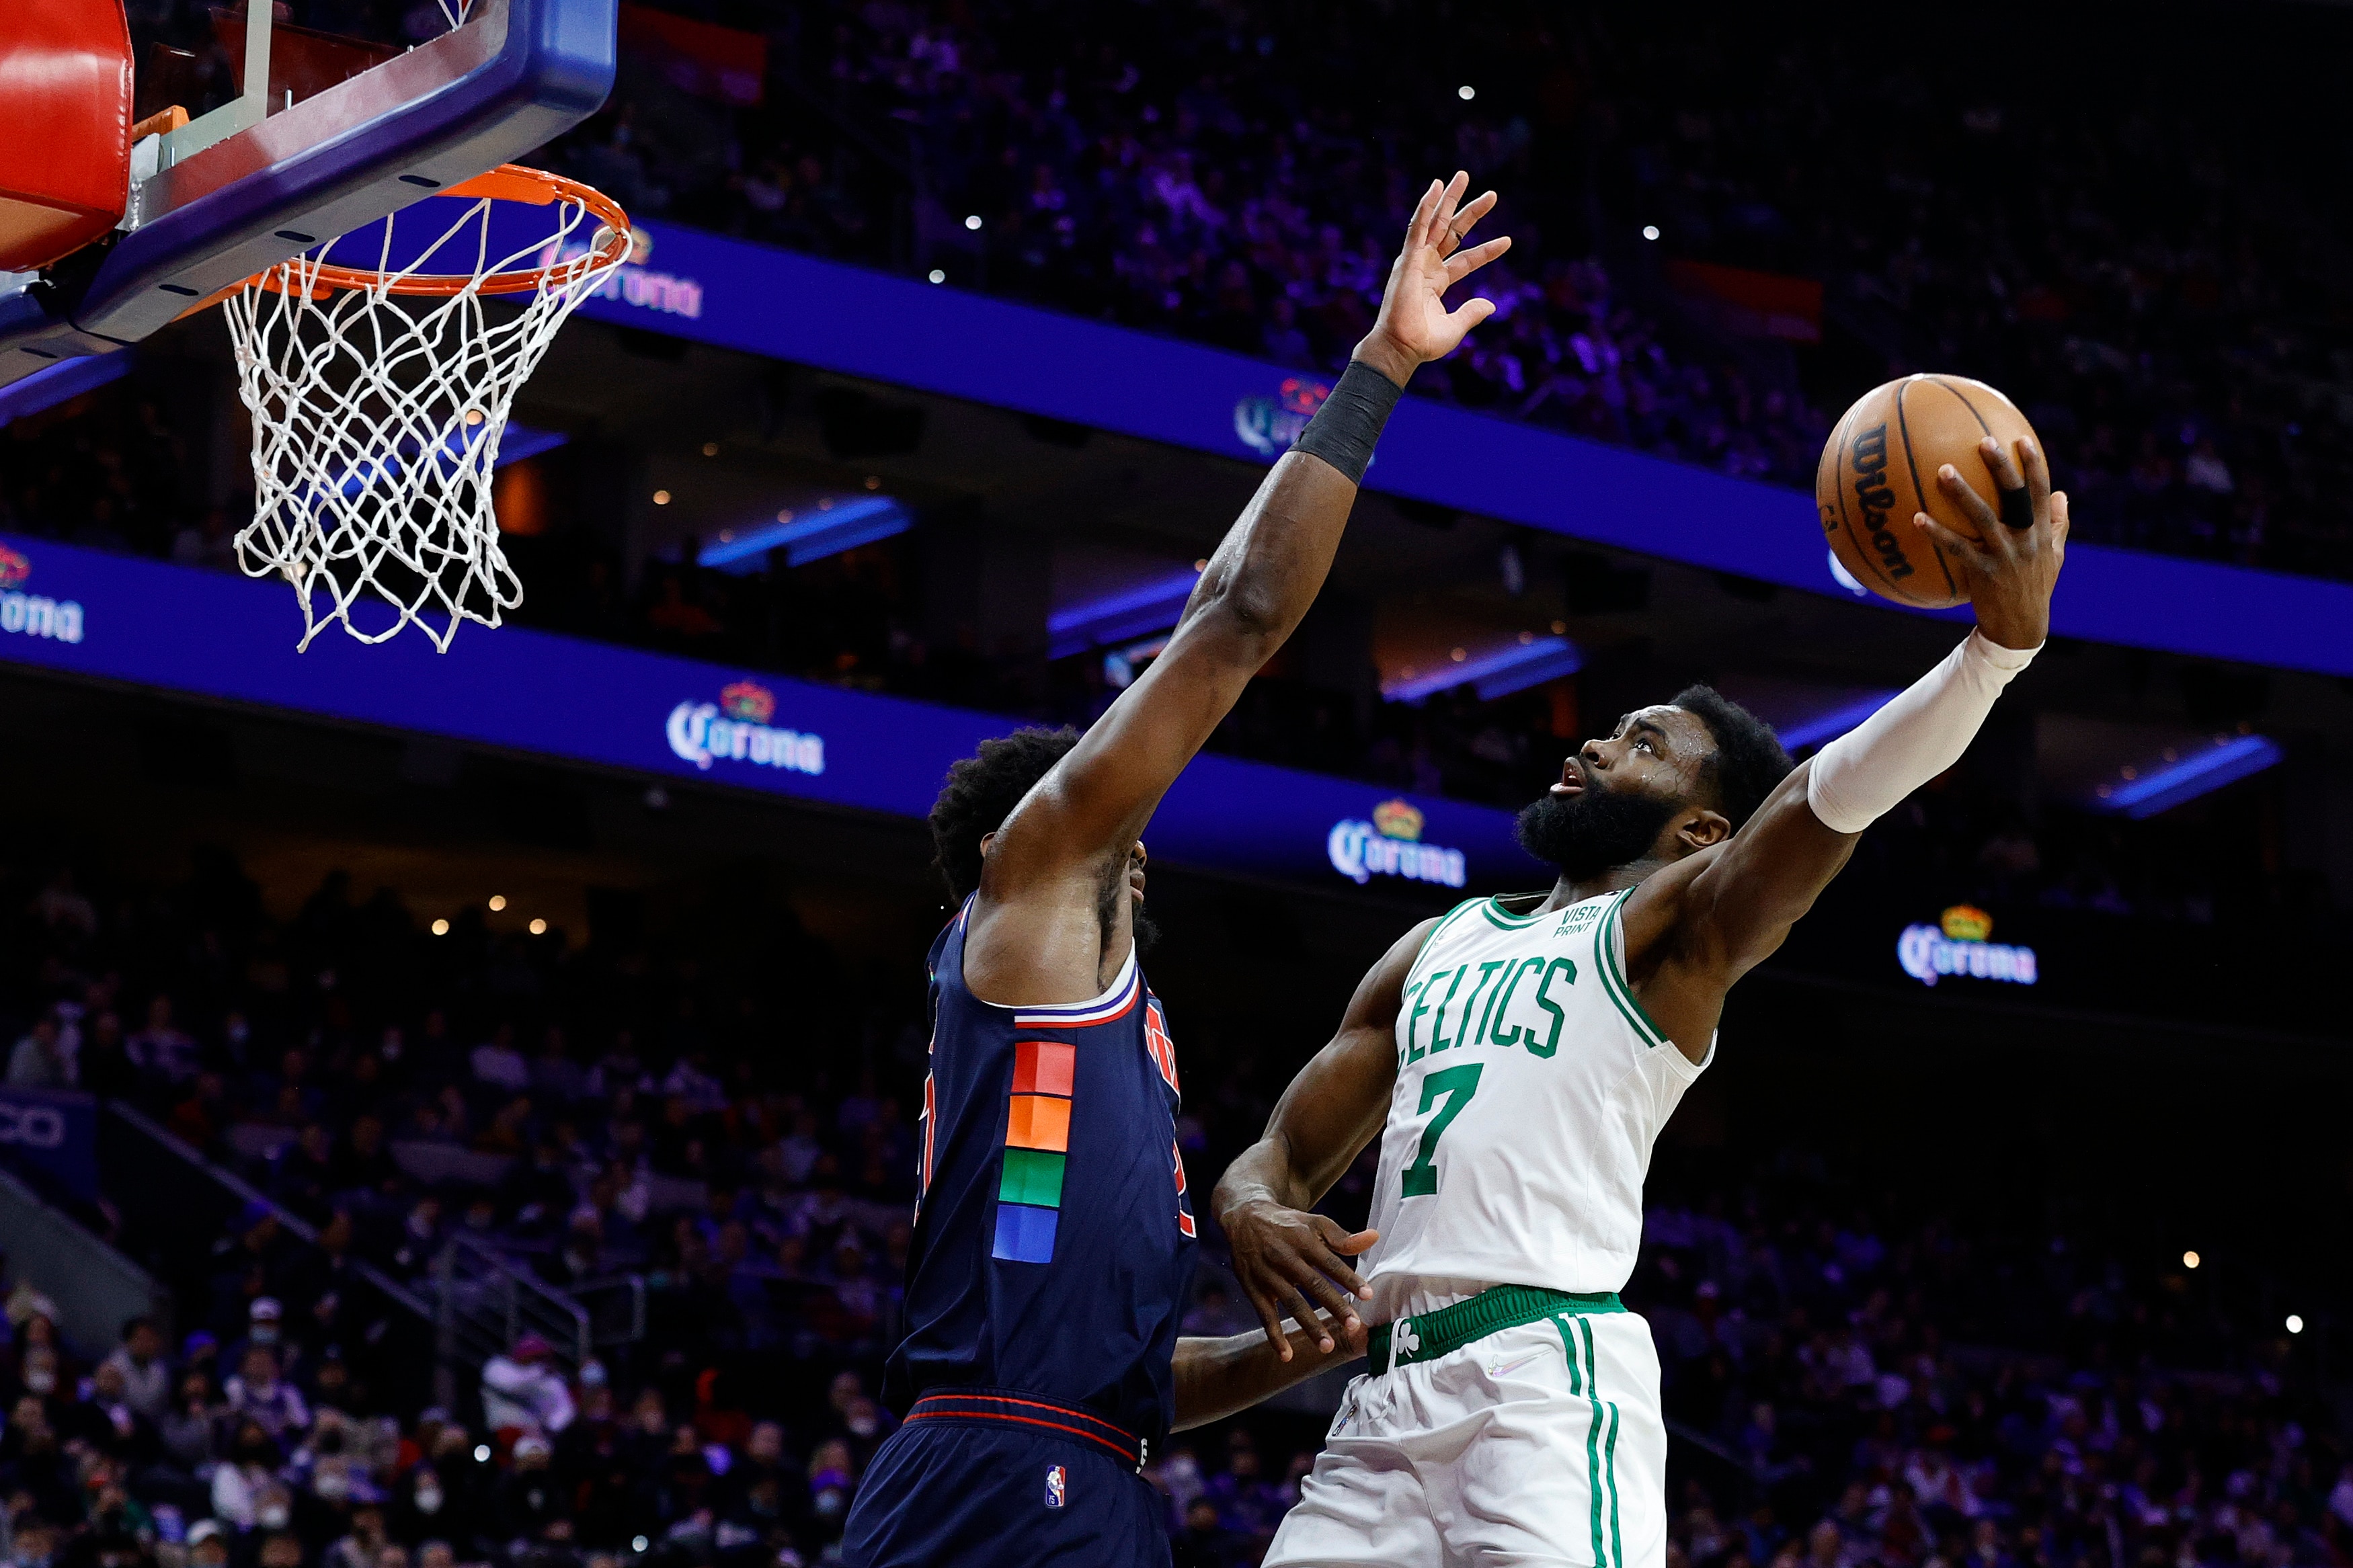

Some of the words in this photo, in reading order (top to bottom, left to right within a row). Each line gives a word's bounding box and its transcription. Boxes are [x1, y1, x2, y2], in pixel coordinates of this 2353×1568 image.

[1851, 421, 1915, 581] Wilson
[0, 590, 84, 644] ona
[666, 701, 825, 776] Corona
[1328, 819, 1466, 889] Corona
[1553, 921, 1593, 938] PRINT
[1562, 906, 1601, 925] VISTA
[1898, 923, 2038, 987] Corona
[1402, 1063, 1484, 1198] 7
